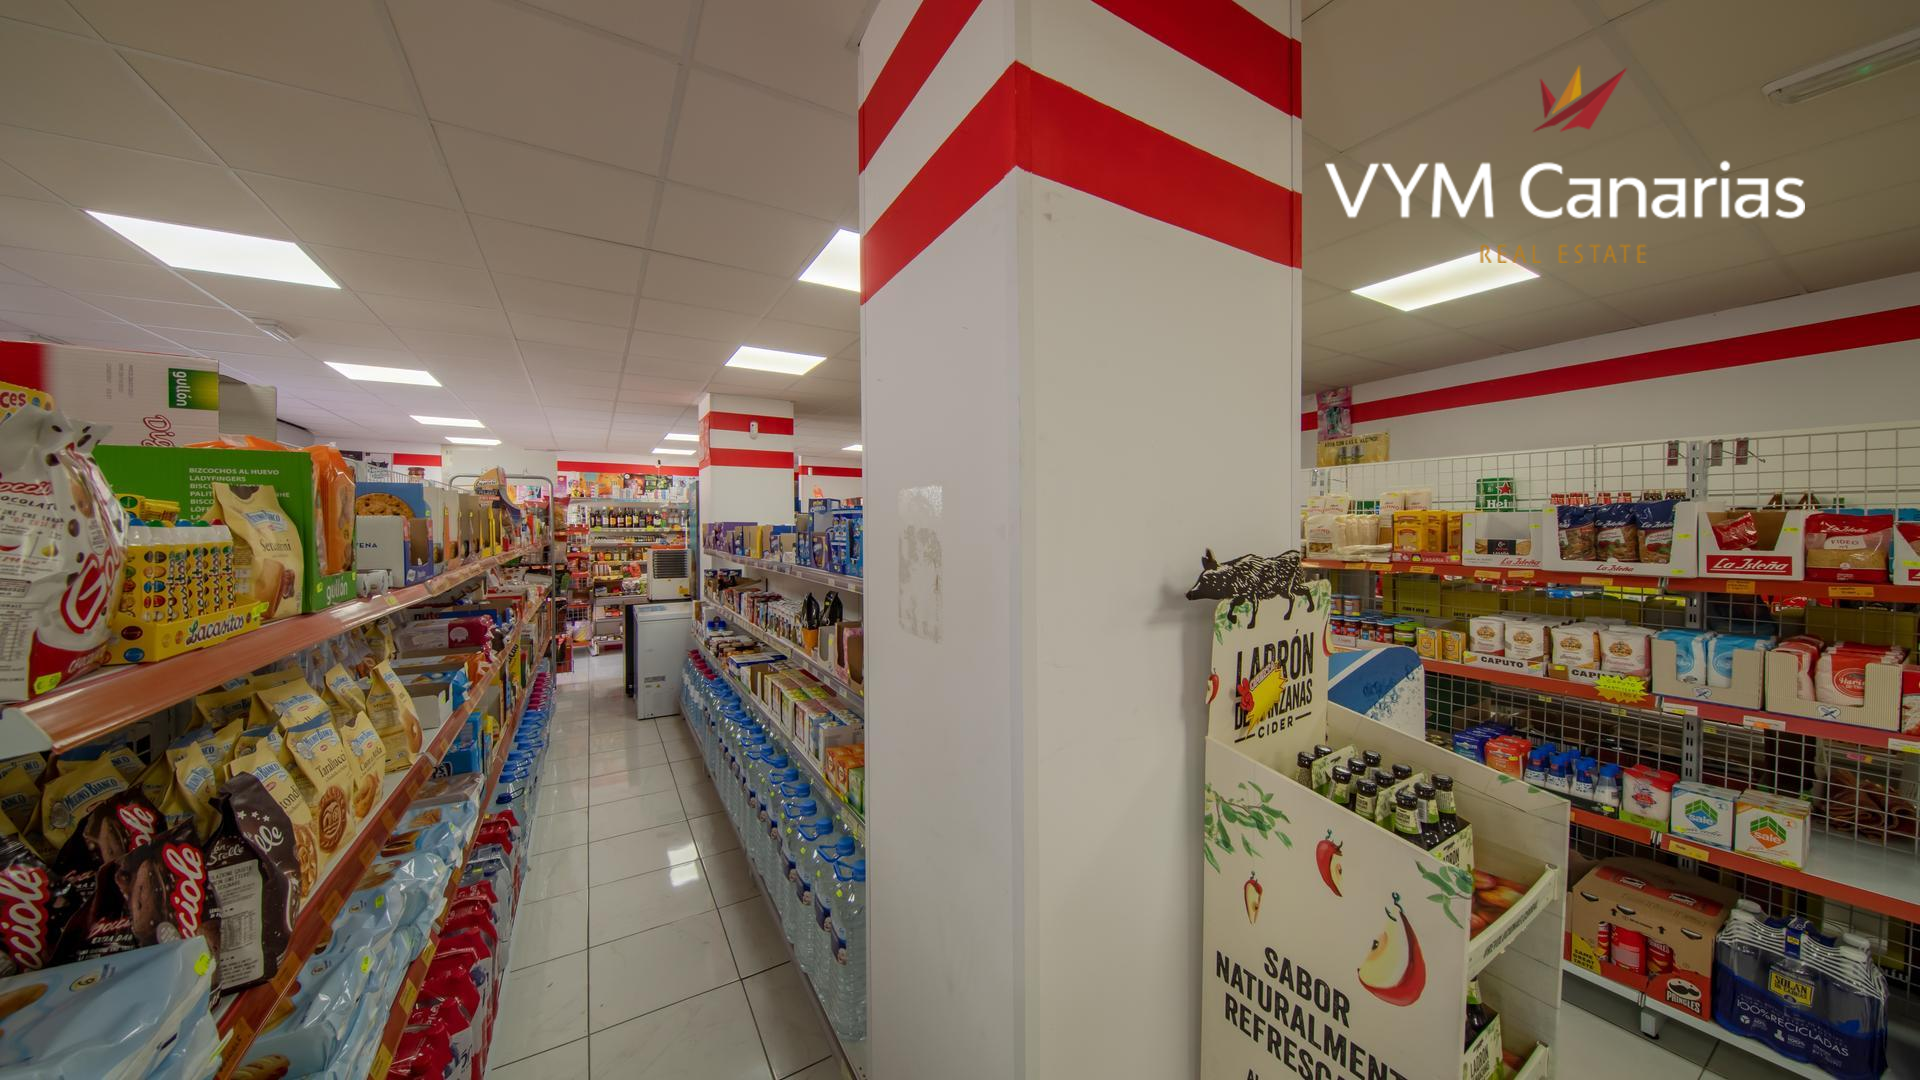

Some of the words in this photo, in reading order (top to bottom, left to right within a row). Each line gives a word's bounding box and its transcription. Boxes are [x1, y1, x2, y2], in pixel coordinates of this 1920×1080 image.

[173, 371, 193, 407] gullón
[189, 467, 237, 475] BIZCOCHOS
[189, 475, 247, 483] LADYFINGERS
[1713, 558, 1734, 570] La
[1735, 557, 1790, 571] Isleña
[185, 613, 245, 646] Lacasitos
[1480, 655, 1524, 669] CAPUTO
[1571, 668, 1625, 681] CAP
[1258, 715, 1293, 738] CIDER
[1687, 813, 1714, 826] sale
[1752, 830, 1782, 845] sale
[1264, 947, 1350, 1028] SABOR
[1666, 990, 1702, 1013] PRINGLES
